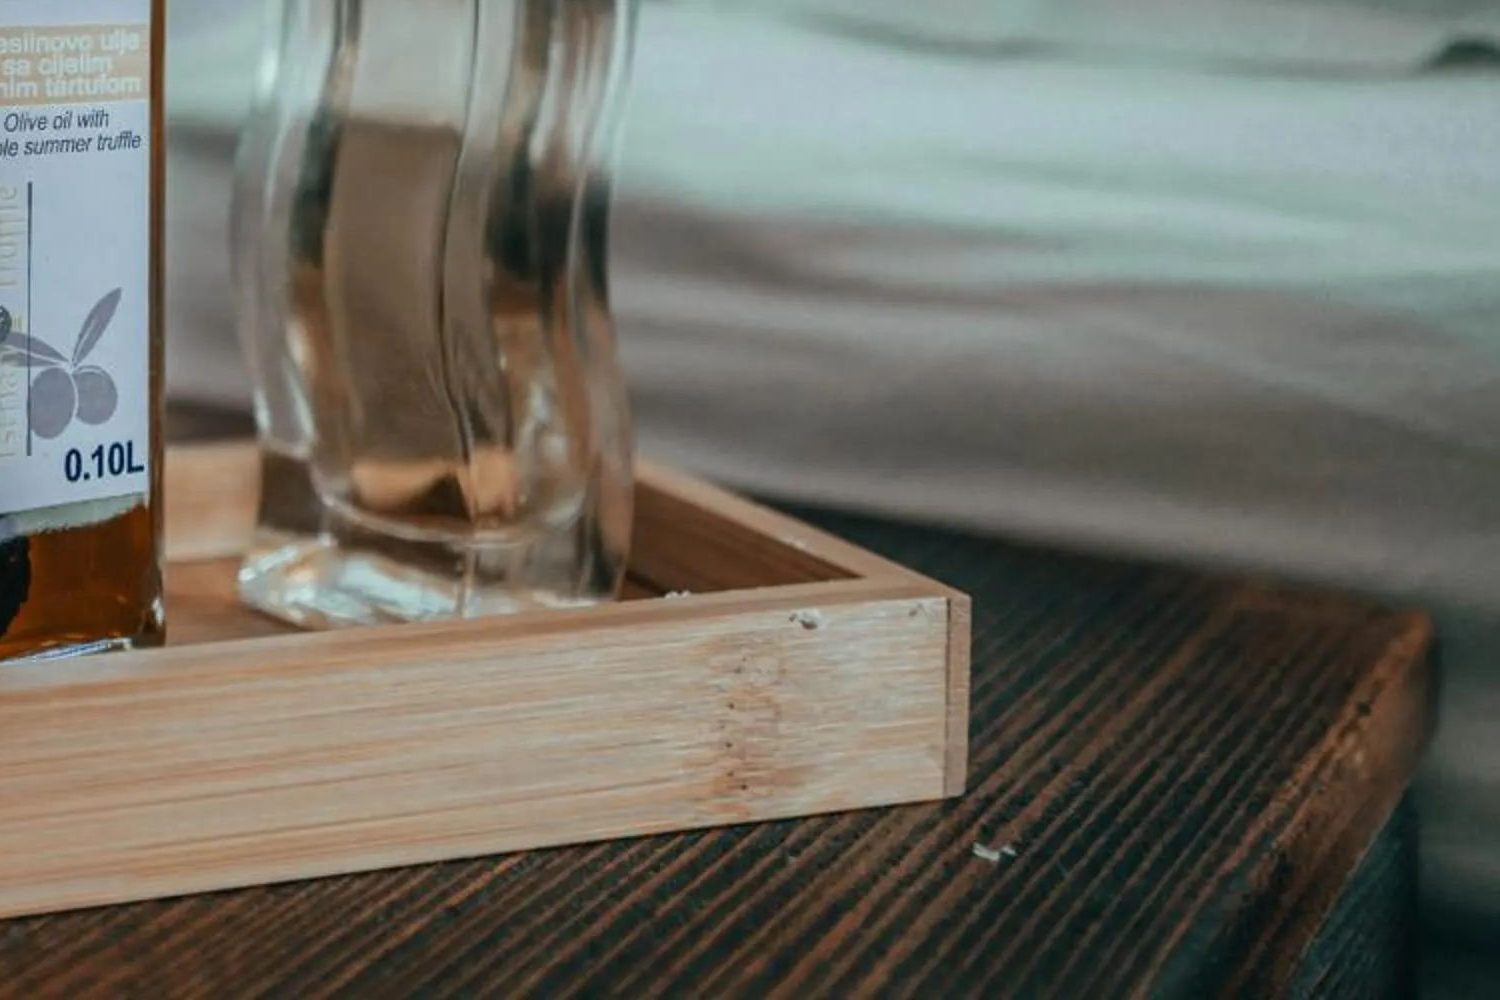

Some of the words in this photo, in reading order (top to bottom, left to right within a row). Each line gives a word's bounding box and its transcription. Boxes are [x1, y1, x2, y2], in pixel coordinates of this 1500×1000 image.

[3, 112, 48, 133] Olive
[52, 111, 73, 131] oil
[77, 109, 110, 129] with
[23, 135, 92, 156] summer
[97, 130, 141, 152] truffle
[64, 440, 146, 483] 0.10L
